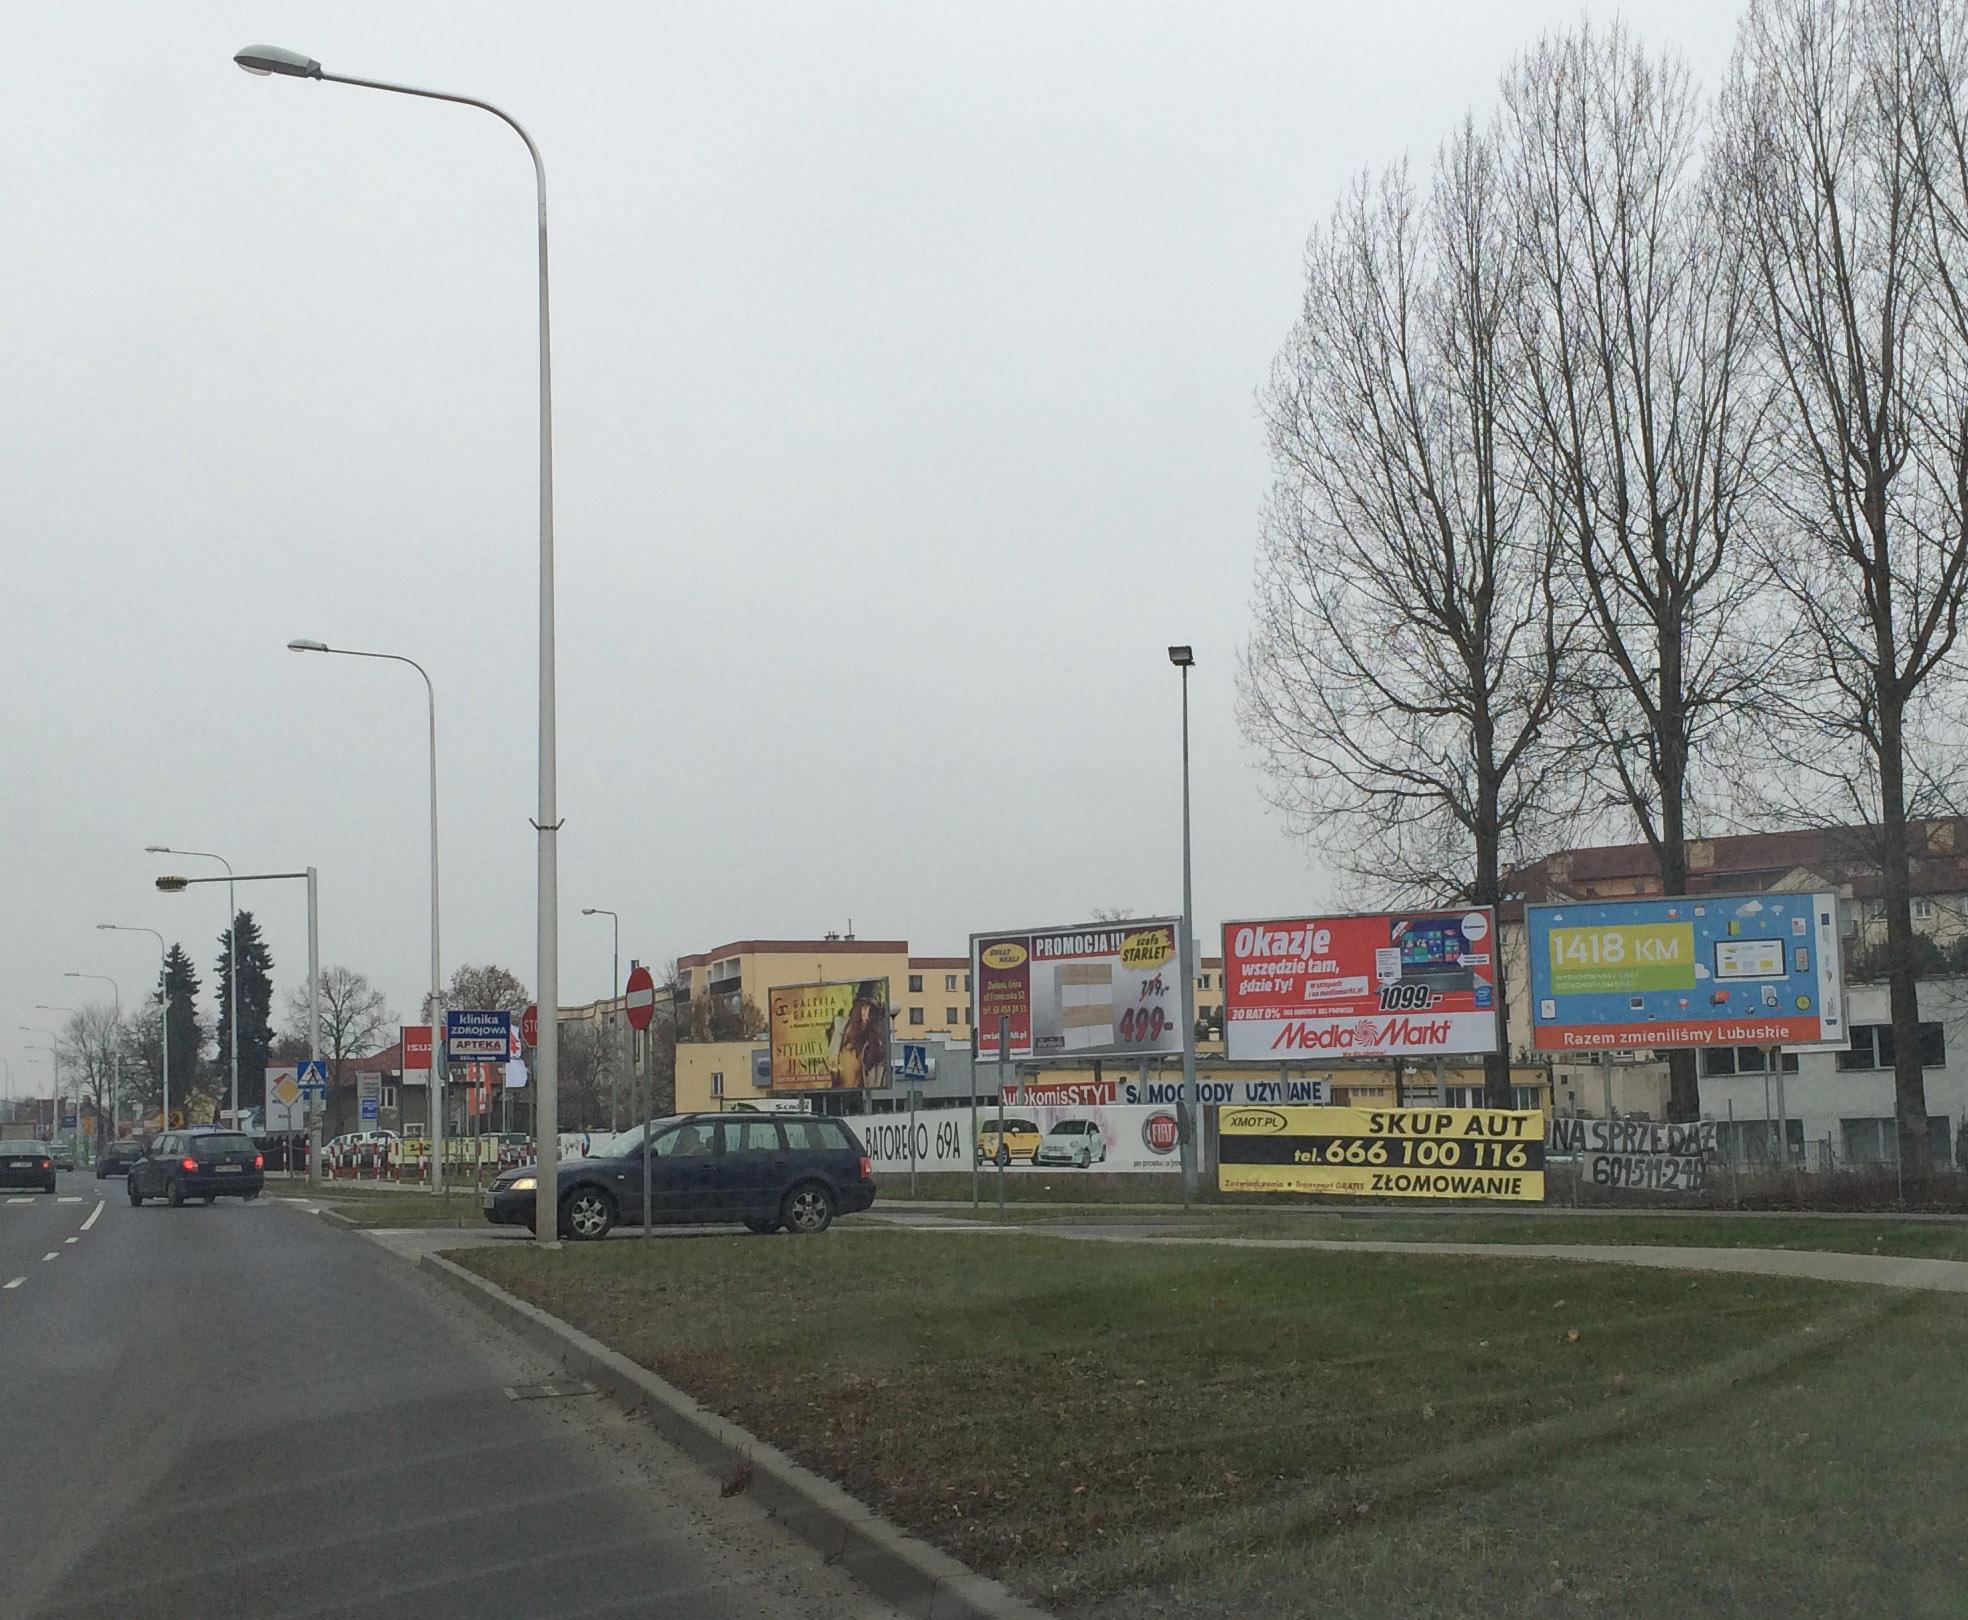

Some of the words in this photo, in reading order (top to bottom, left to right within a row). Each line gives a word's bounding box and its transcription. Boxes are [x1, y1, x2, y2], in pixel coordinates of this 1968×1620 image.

[1036, 934, 1108, 957] PROMOCJA
[1234, 923, 1331, 960] Okazje
[1554, 933, 1625, 965] 1418
[1634, 937, 1678, 961] KM
[1122, 946, 1168, 962] STARLET
[1241, 959, 1306, 977] wszędzie
[1307, 959, 1340, 974] tam,
[1239, 978, 1273, 995] gdzie
[1274, 977, 1294, 993] Ty!
[459, 1014, 499, 1025] klinika
[1232, 1010, 1245, 1020] 30
[1245, 1008, 1264, 1019] RAT
[1264, 1007, 1281, 1019] 0%
[450, 1026, 507, 1036] ZDROJOWA
[1564, 1031, 1615, 1045] Razem
[1619, 1029, 1712, 1043] zmieniliśmy
[1717, 1025, 1789, 1040] Lubuskie
[456, 1040, 501, 1050] APTEKA
[1230, 1117, 1278, 1128] XMOT.PL
[1369, 1113, 1453, 1135] SKUP
[1463, 1115, 1528, 1137] AUT
[936, 1121, 960, 1159] 69A
[1152, 1123, 1174, 1142] FIAT
[1552, 1118, 1587, 1150] NA
[1294, 1148, 1322, 1162] tel.
[1326, 1139, 1388, 1164] 666
[1402, 1140, 1461, 1166] 100
[1474, 1142, 1528, 1168] 116
[1336, 1181, 1365, 1190] GRATIS
[1371, 1173, 1522, 1195] ZŁOMOWANIE
